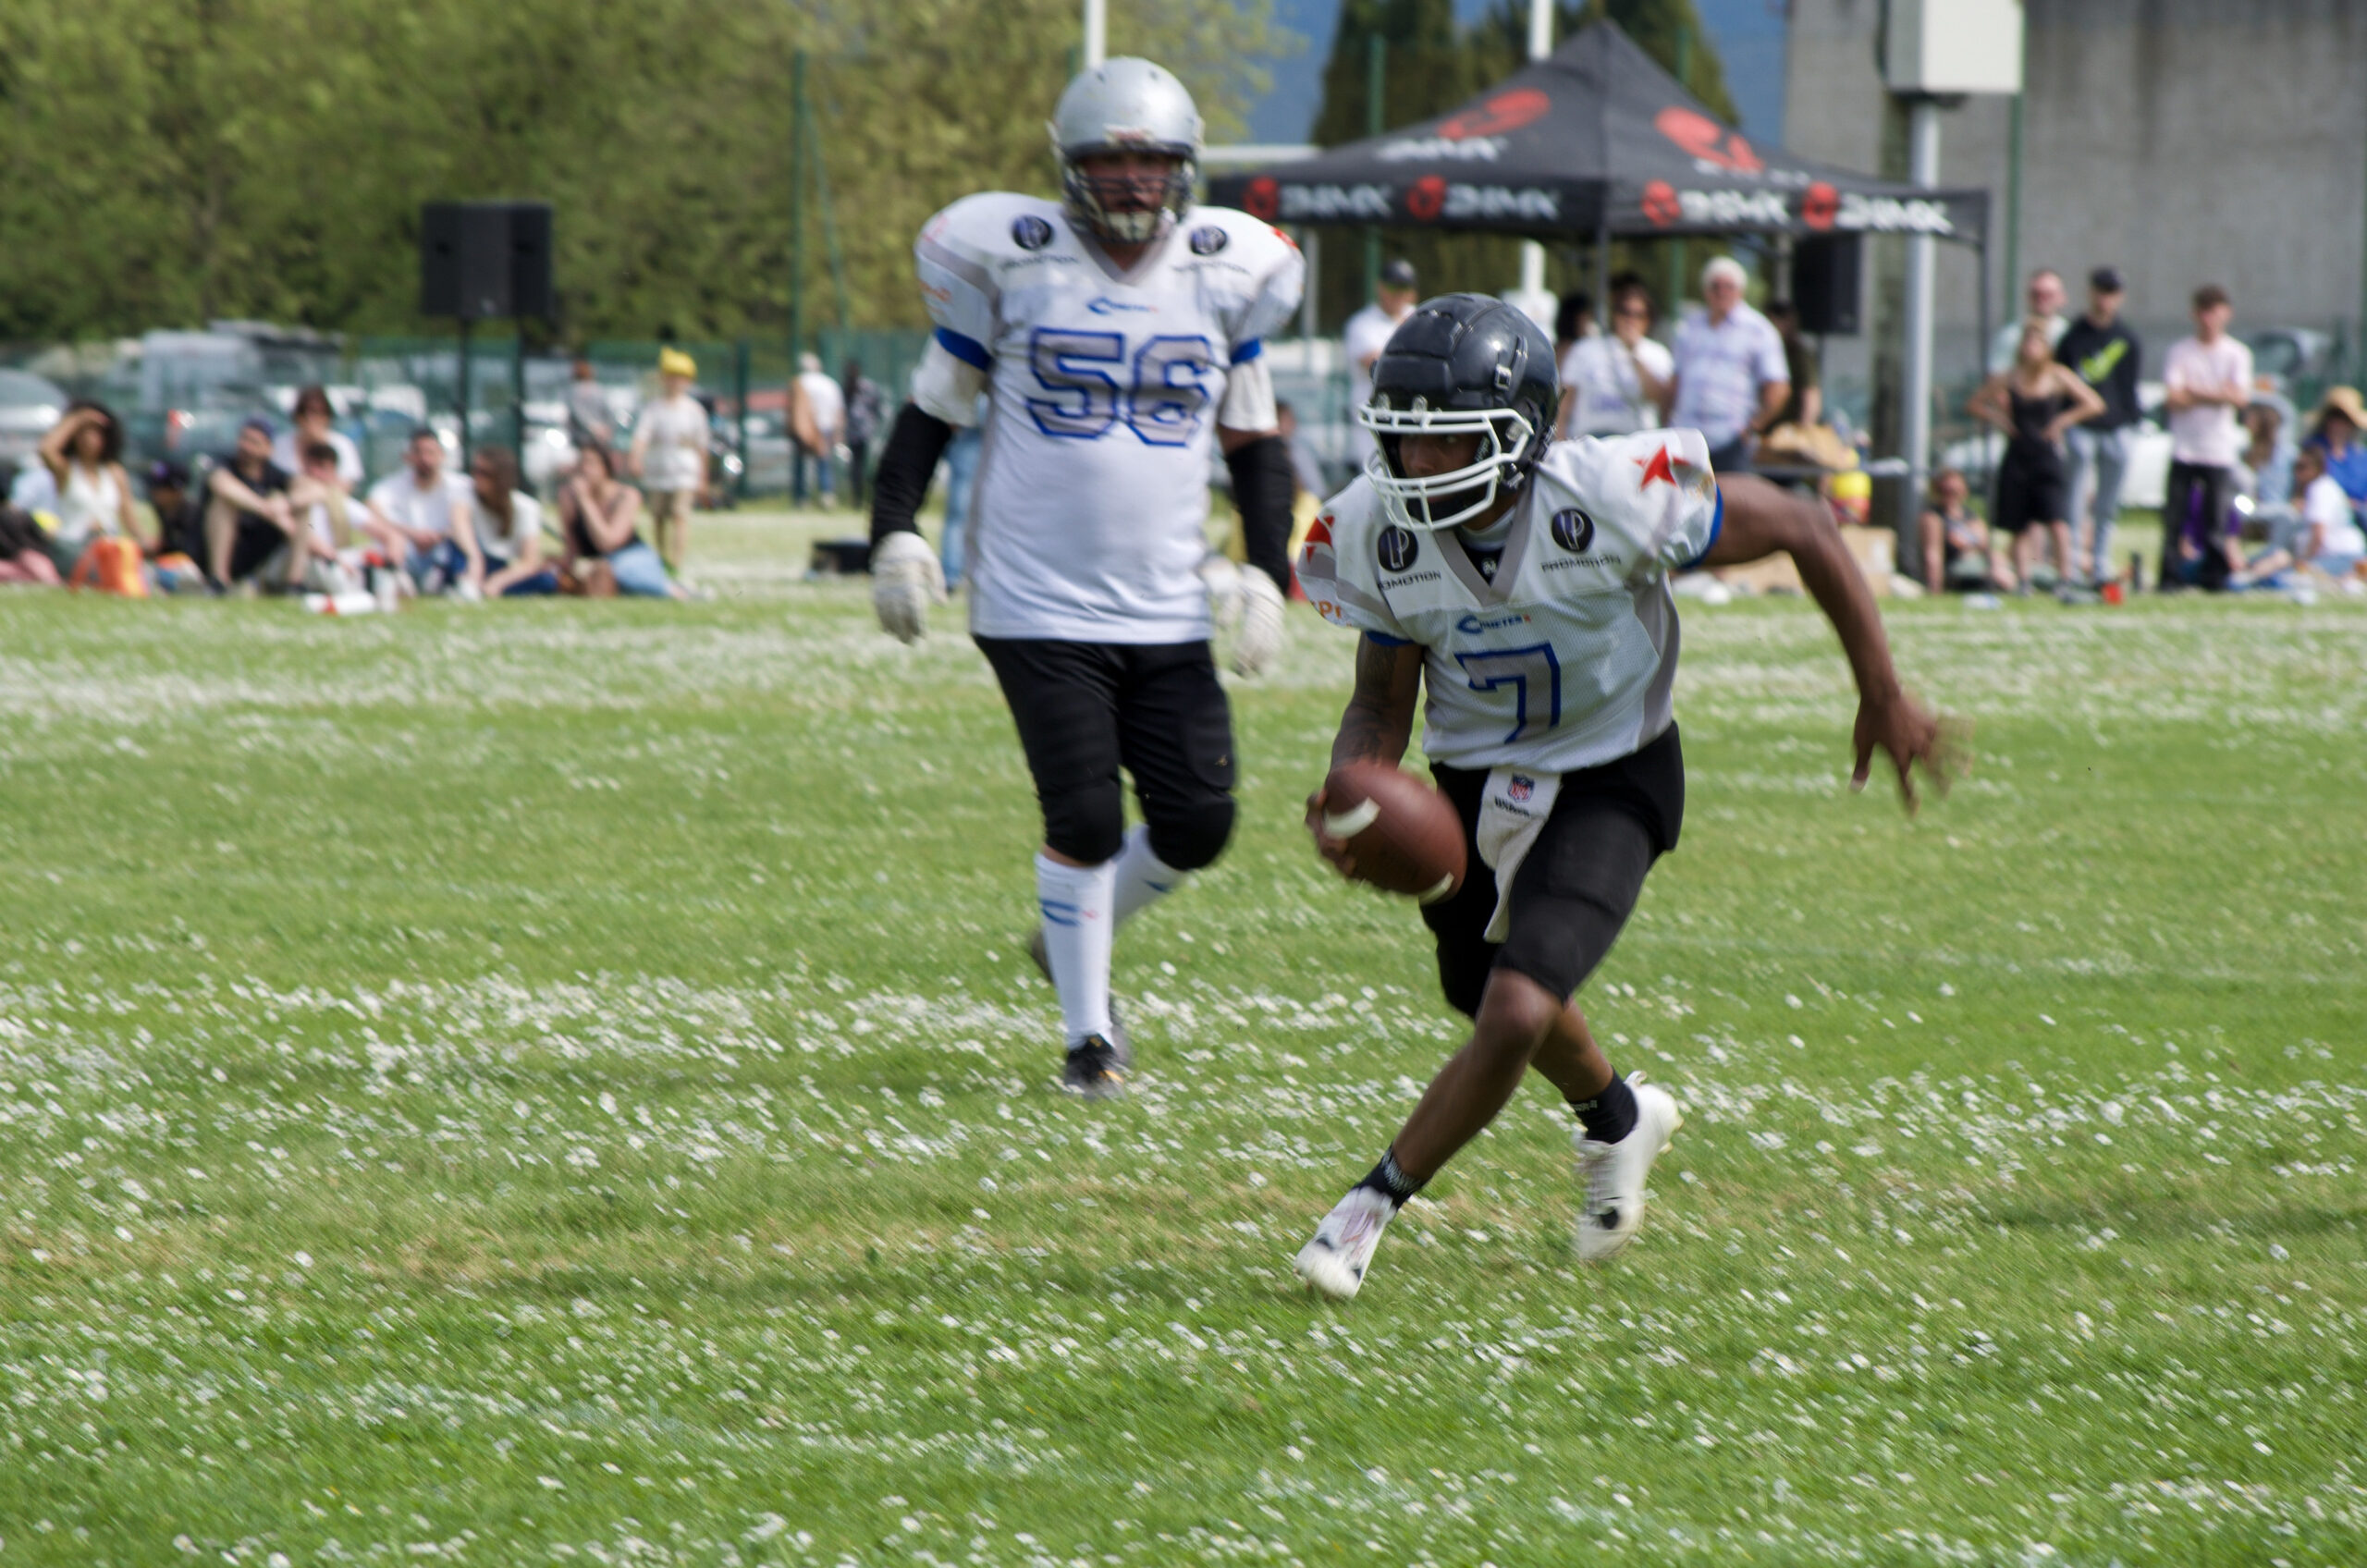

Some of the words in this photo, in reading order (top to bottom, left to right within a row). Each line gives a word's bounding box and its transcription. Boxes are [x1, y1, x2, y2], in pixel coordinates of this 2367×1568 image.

[1025, 325, 1217, 448] 56
[1381, 570, 1442, 591] OMOTION
[1540, 555, 1622, 573] PROMOTION
[1453, 640, 1562, 745] 7
